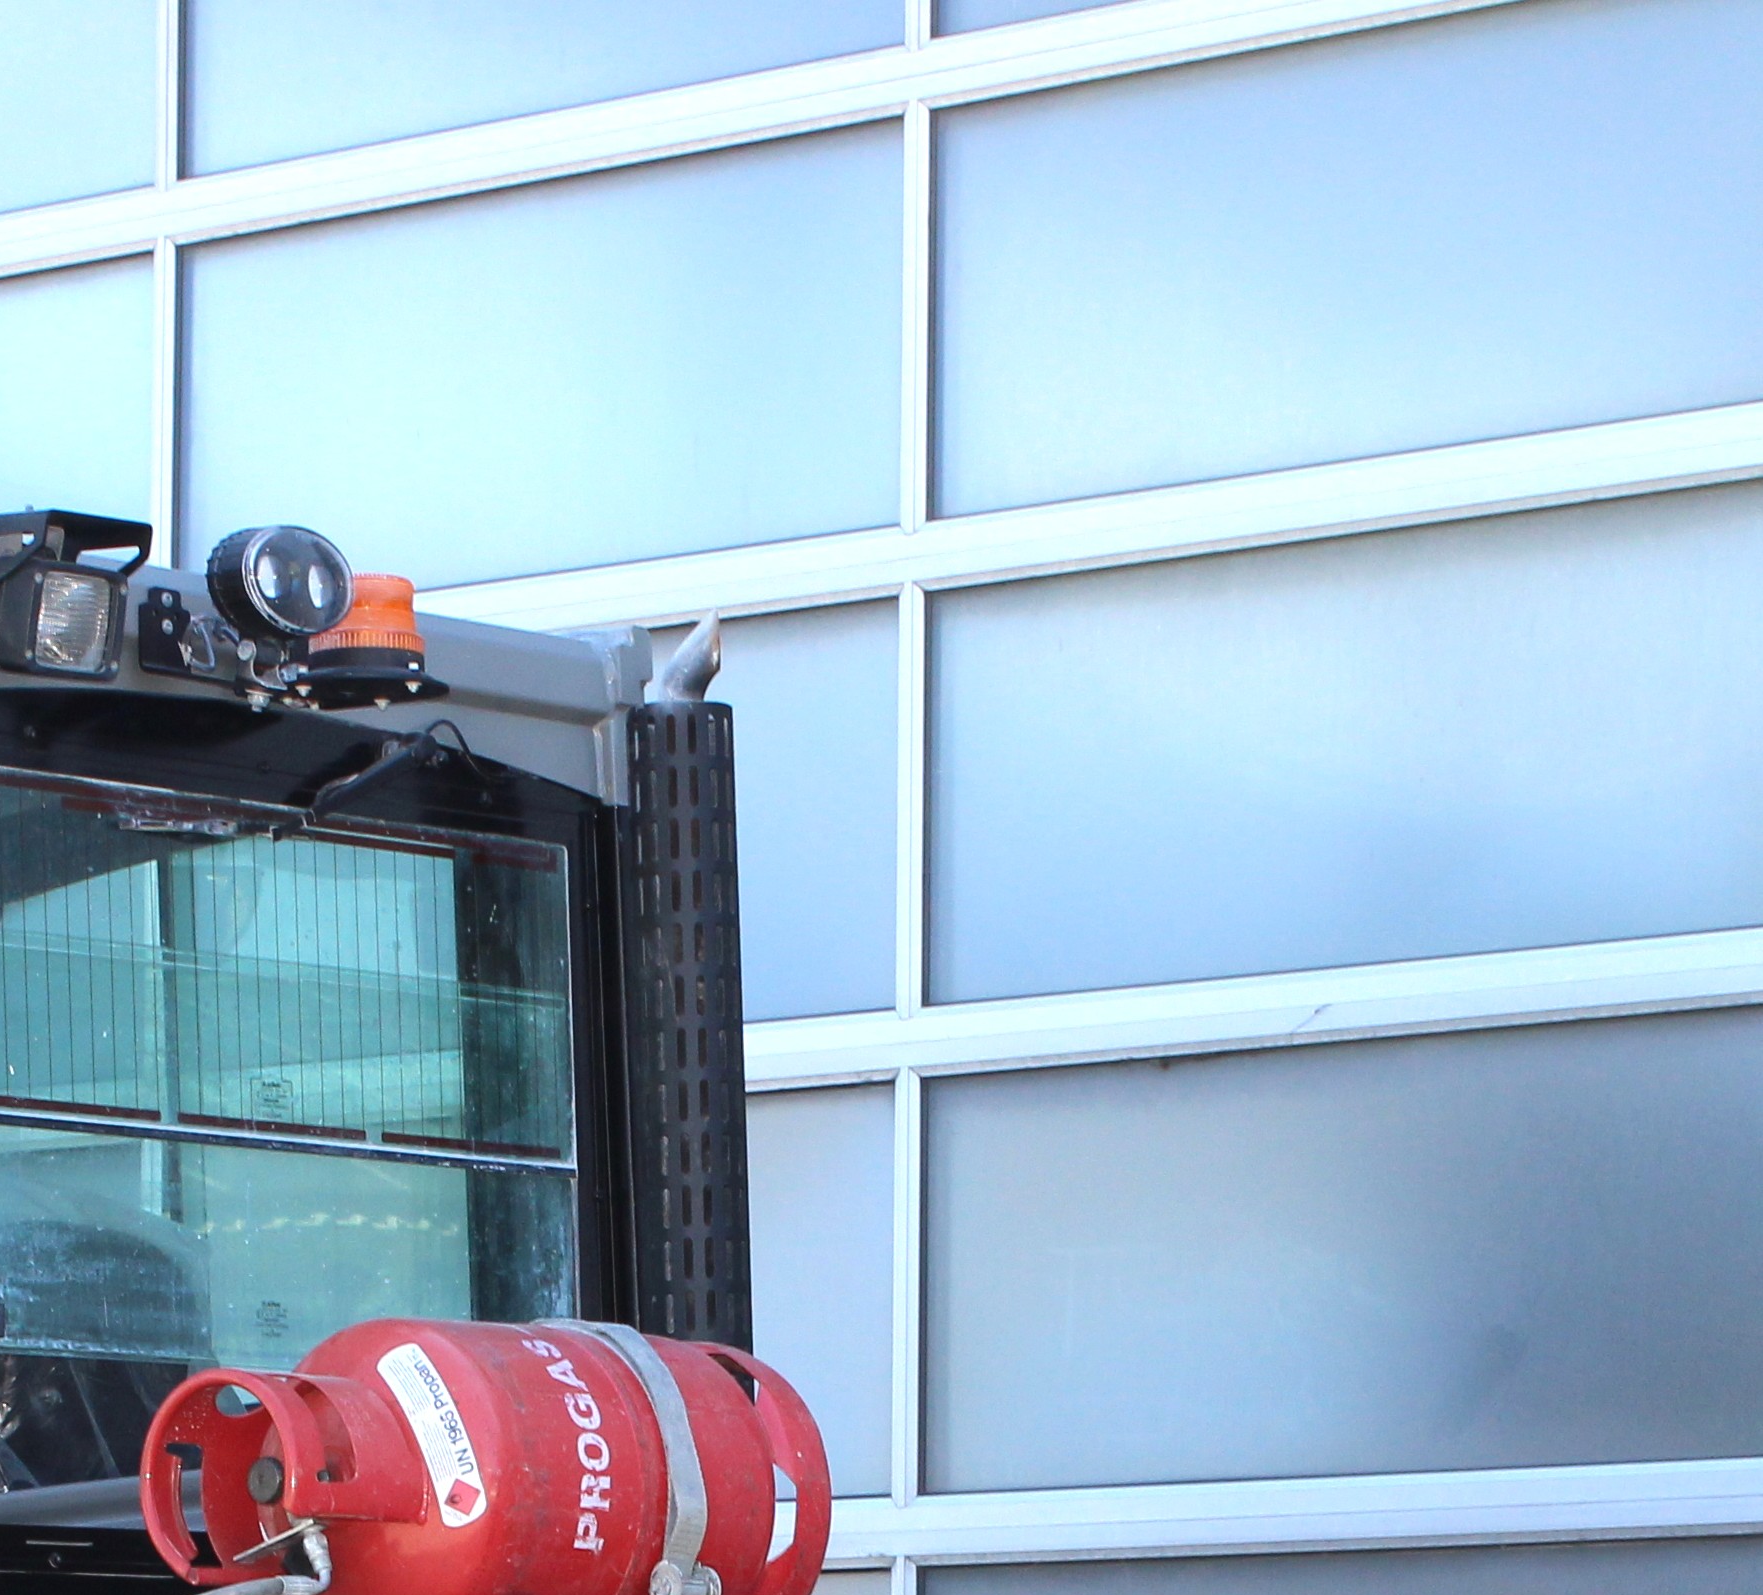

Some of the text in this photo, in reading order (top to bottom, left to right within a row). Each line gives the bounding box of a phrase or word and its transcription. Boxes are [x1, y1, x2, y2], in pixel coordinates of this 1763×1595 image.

[413, 1359, 447, 1410] Propan
[440, 1410, 465, 1446] 1965
[522, 1338, 613, 1556] PROGAS
[454, 1447, 475, 1476] UN
